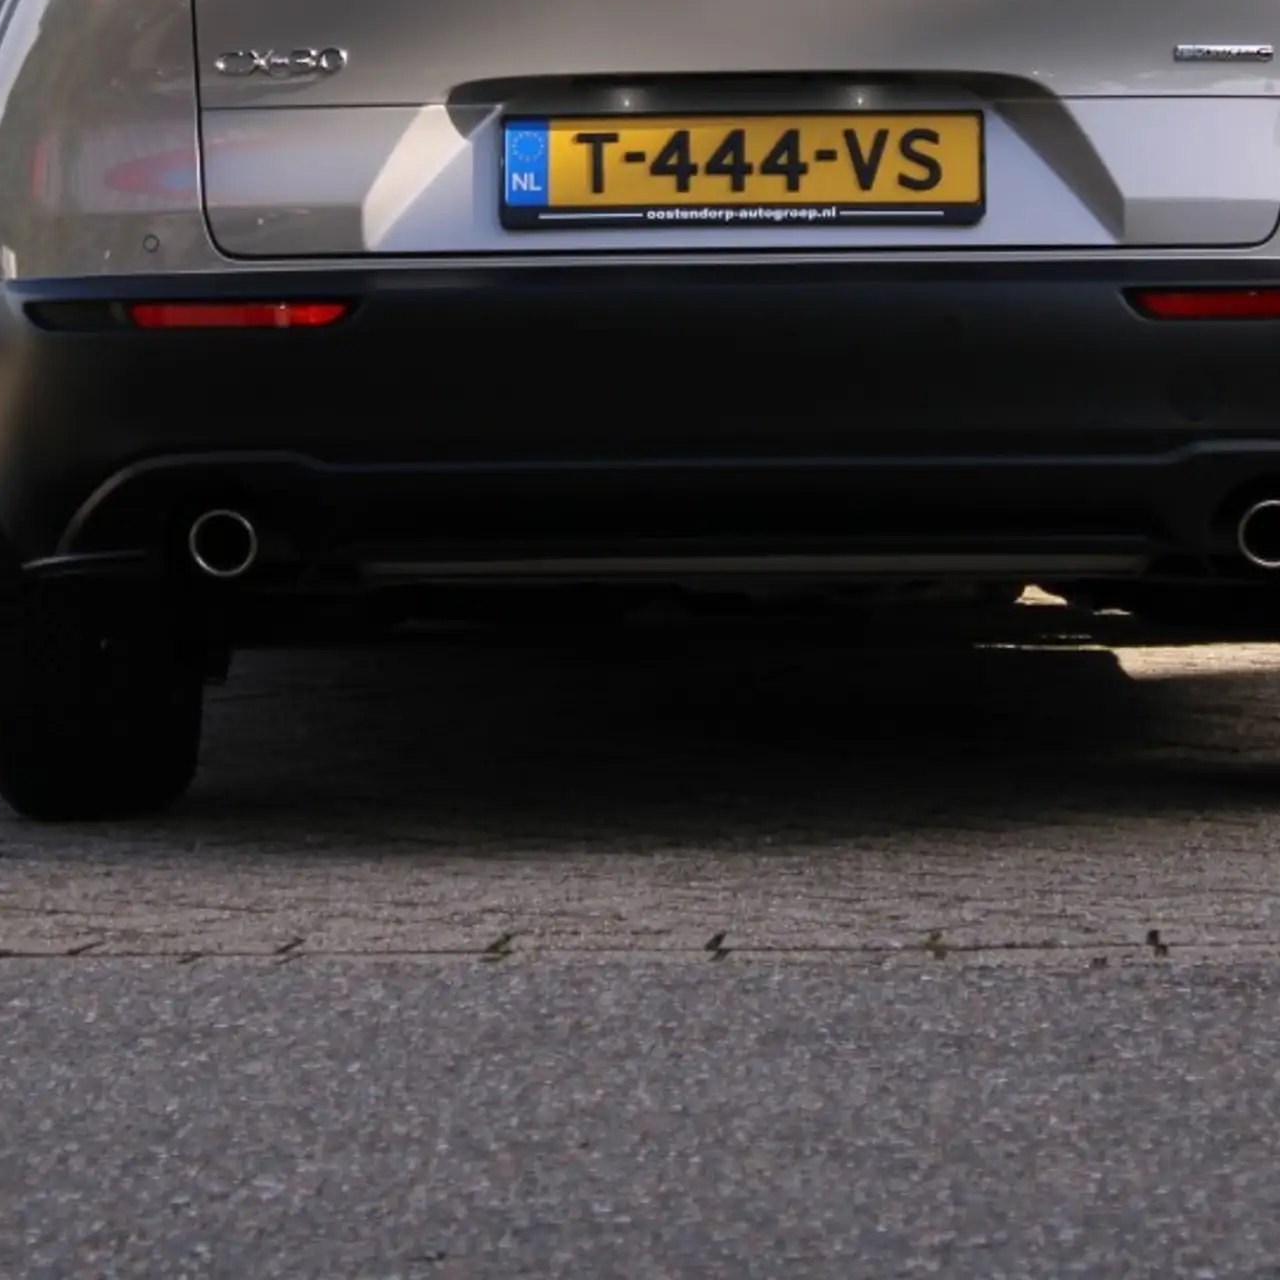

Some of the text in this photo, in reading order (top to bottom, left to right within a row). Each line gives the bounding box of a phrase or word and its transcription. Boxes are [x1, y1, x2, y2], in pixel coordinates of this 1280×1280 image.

[214, 48, 349, 77] CX-30
[573, 128, 944, 194] T-444-VS
[511, 172, 542, 192] NL
[645, 205, 838, 222] oostendorp-autogroep.nl
